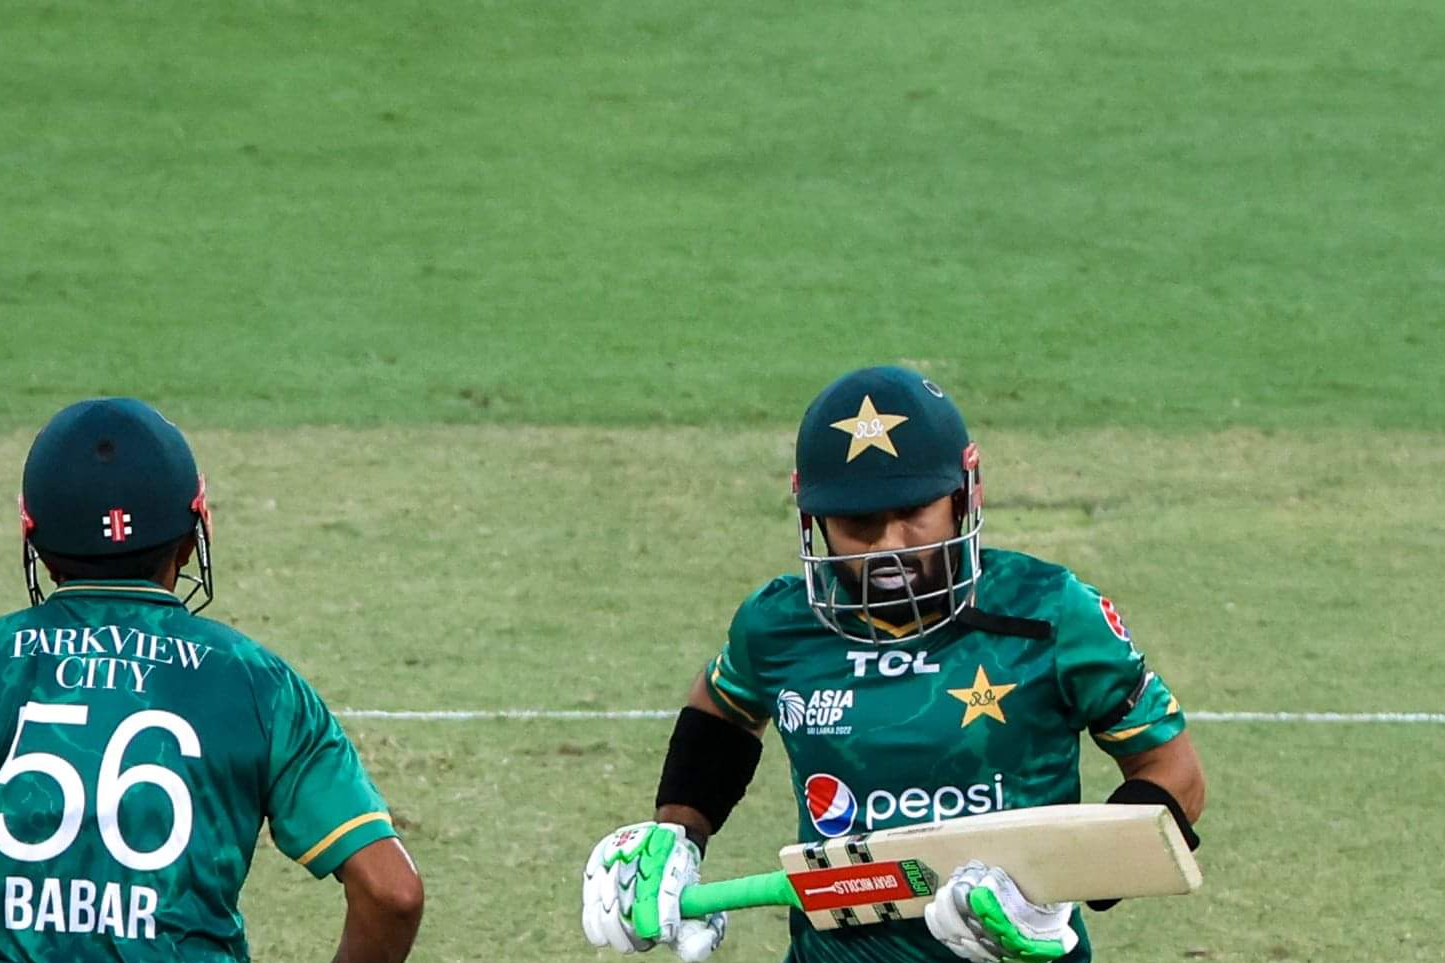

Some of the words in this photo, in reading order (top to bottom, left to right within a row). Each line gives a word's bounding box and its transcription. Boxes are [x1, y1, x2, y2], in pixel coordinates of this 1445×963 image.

[10, 624, 213, 671] PARKVIEW
[846, 650, 940, 677] TCL
[56, 657, 157, 693] CITY
[805, 707, 843, 726] CUP
[808, 689, 854, 708] ASIA
[865, 774, 1004, 830] pepsi
[4, 876, 158, 940] BABAR
